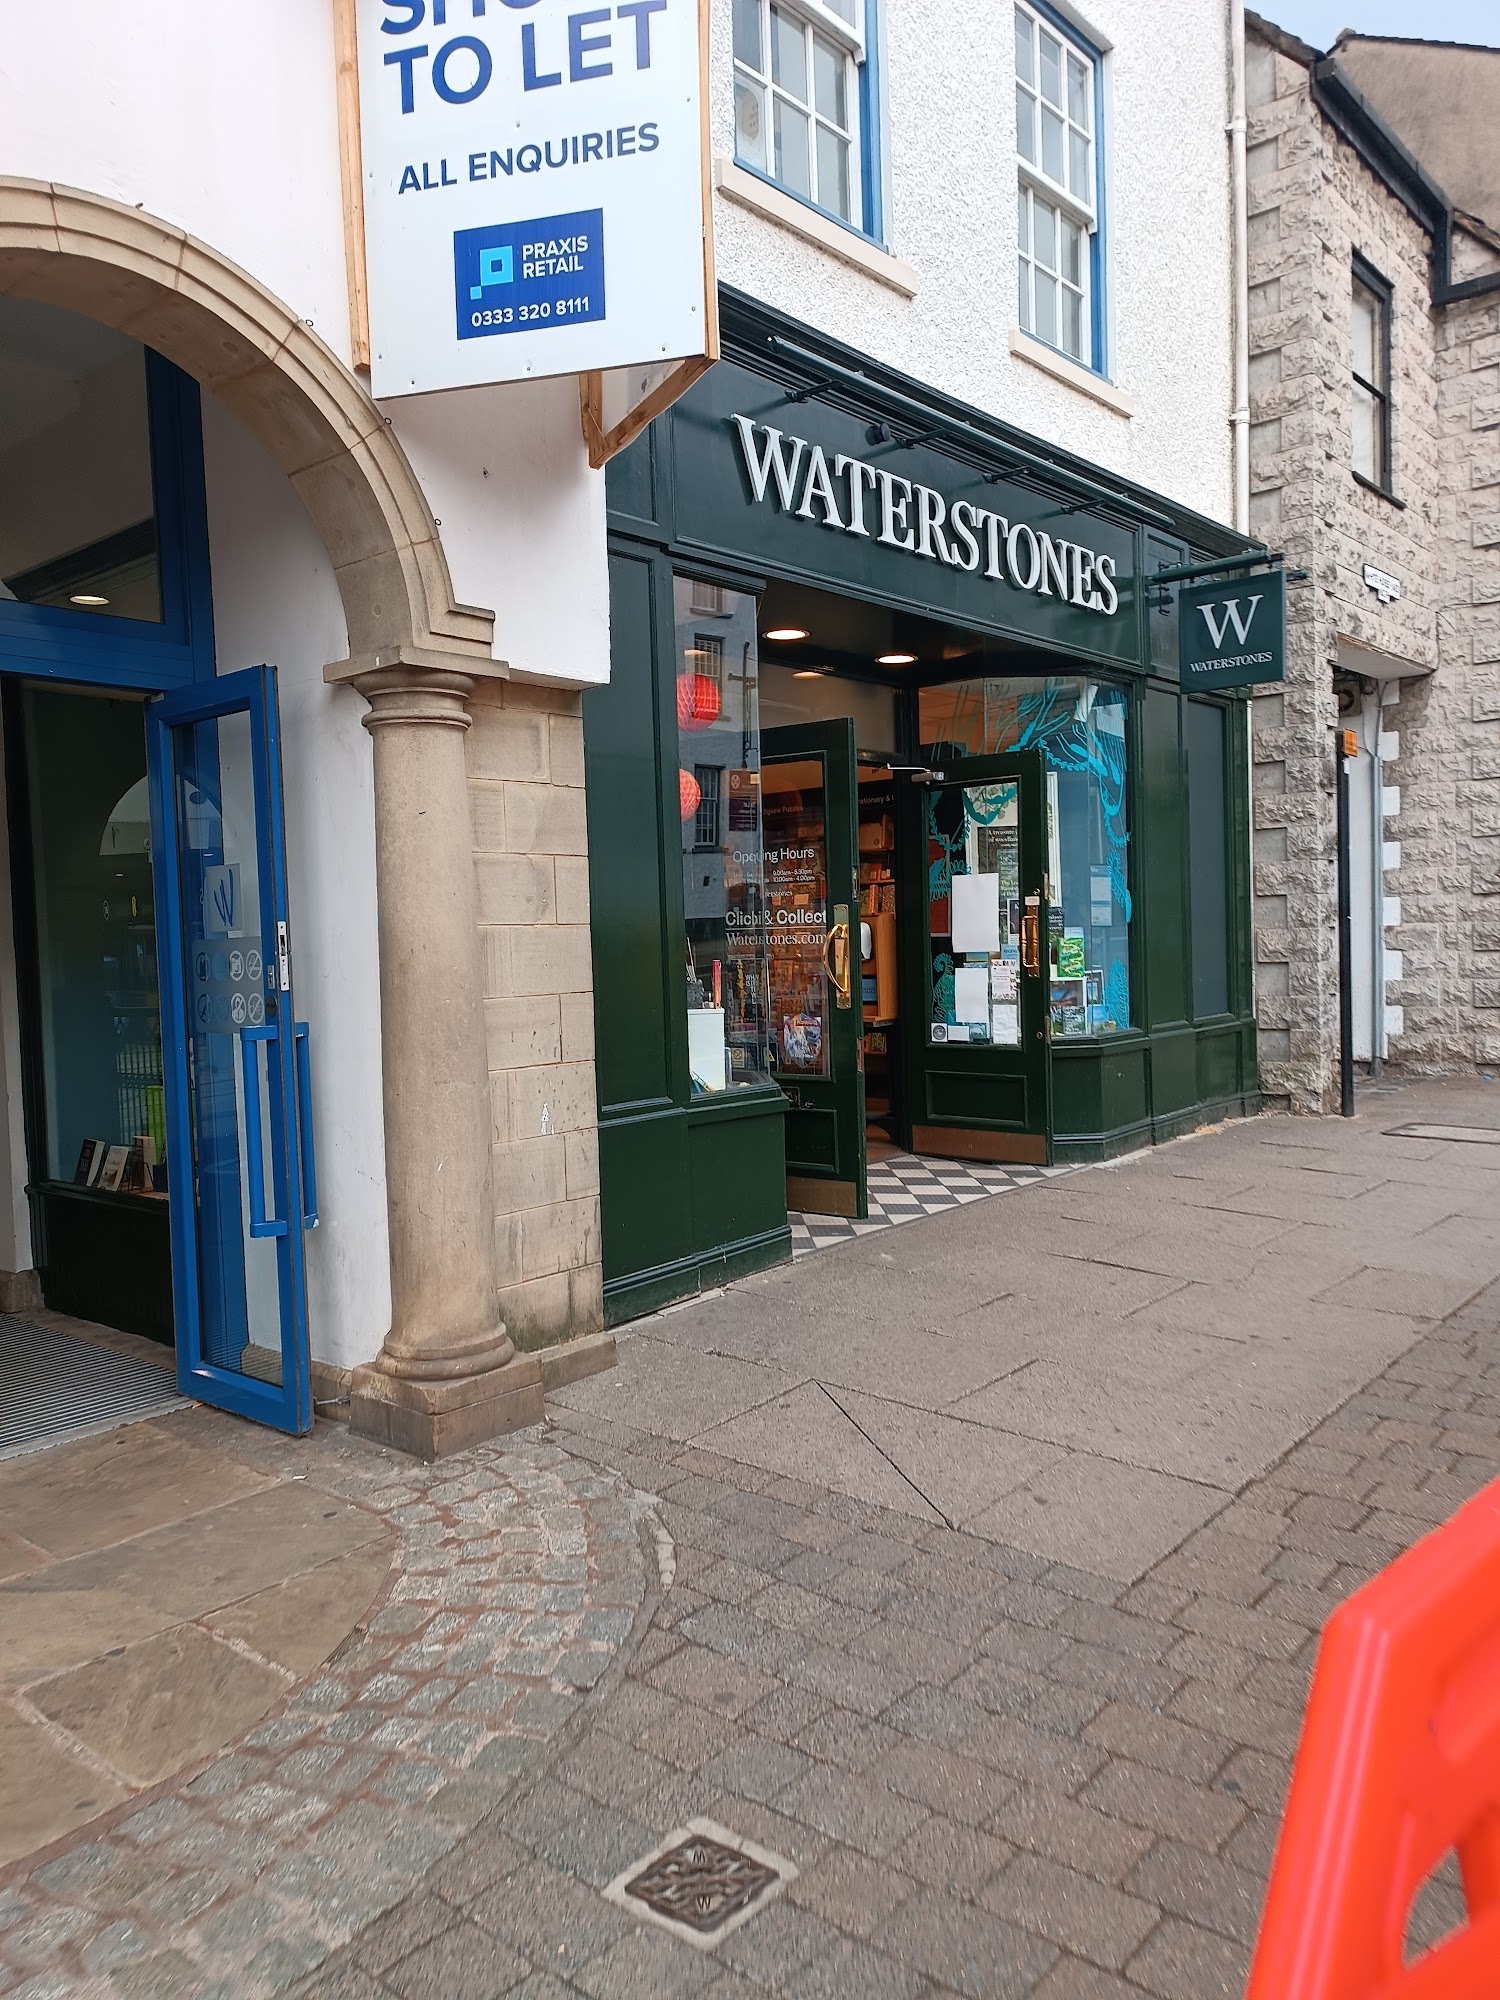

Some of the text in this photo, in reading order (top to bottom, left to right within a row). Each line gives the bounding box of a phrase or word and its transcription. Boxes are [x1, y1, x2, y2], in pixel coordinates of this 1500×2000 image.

[384, 35, 493, 115] TO
[521, 0, 668, 92] LET
[398, 122, 660, 195] ALL ENQUIRIES
[522, 235, 589, 261] PRAXIS
[523, 255, 584, 279] RETAIL
[471, 296, 590, 328] 0333 320 8111
[730, 413, 1119, 616] WATERSTONES
[1196, 594, 1265, 650] W
[1189, 651, 1273, 673] WATERSTONES
[780, 847, 815, 860] Hours
[764, 910, 774, 925] &
[776, 908, 827, 925] Collect
